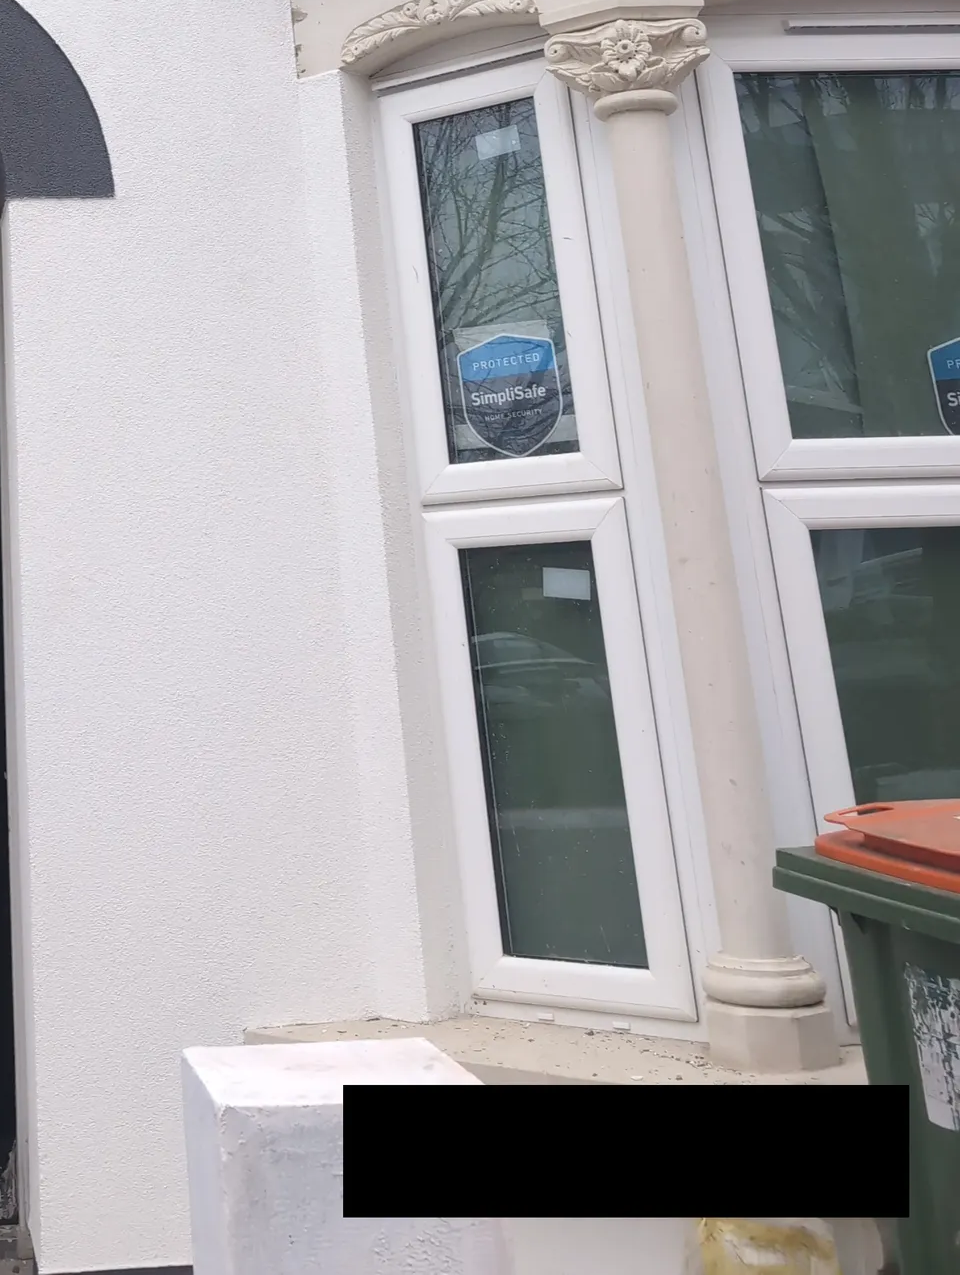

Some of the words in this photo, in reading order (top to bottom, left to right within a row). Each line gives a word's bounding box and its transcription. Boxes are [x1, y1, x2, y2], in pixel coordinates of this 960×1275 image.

[472, 352, 540, 371] PROTECTED
[471, 383, 546, 406] SimpliSafe
[507, 408, 542, 419] SECURITY
